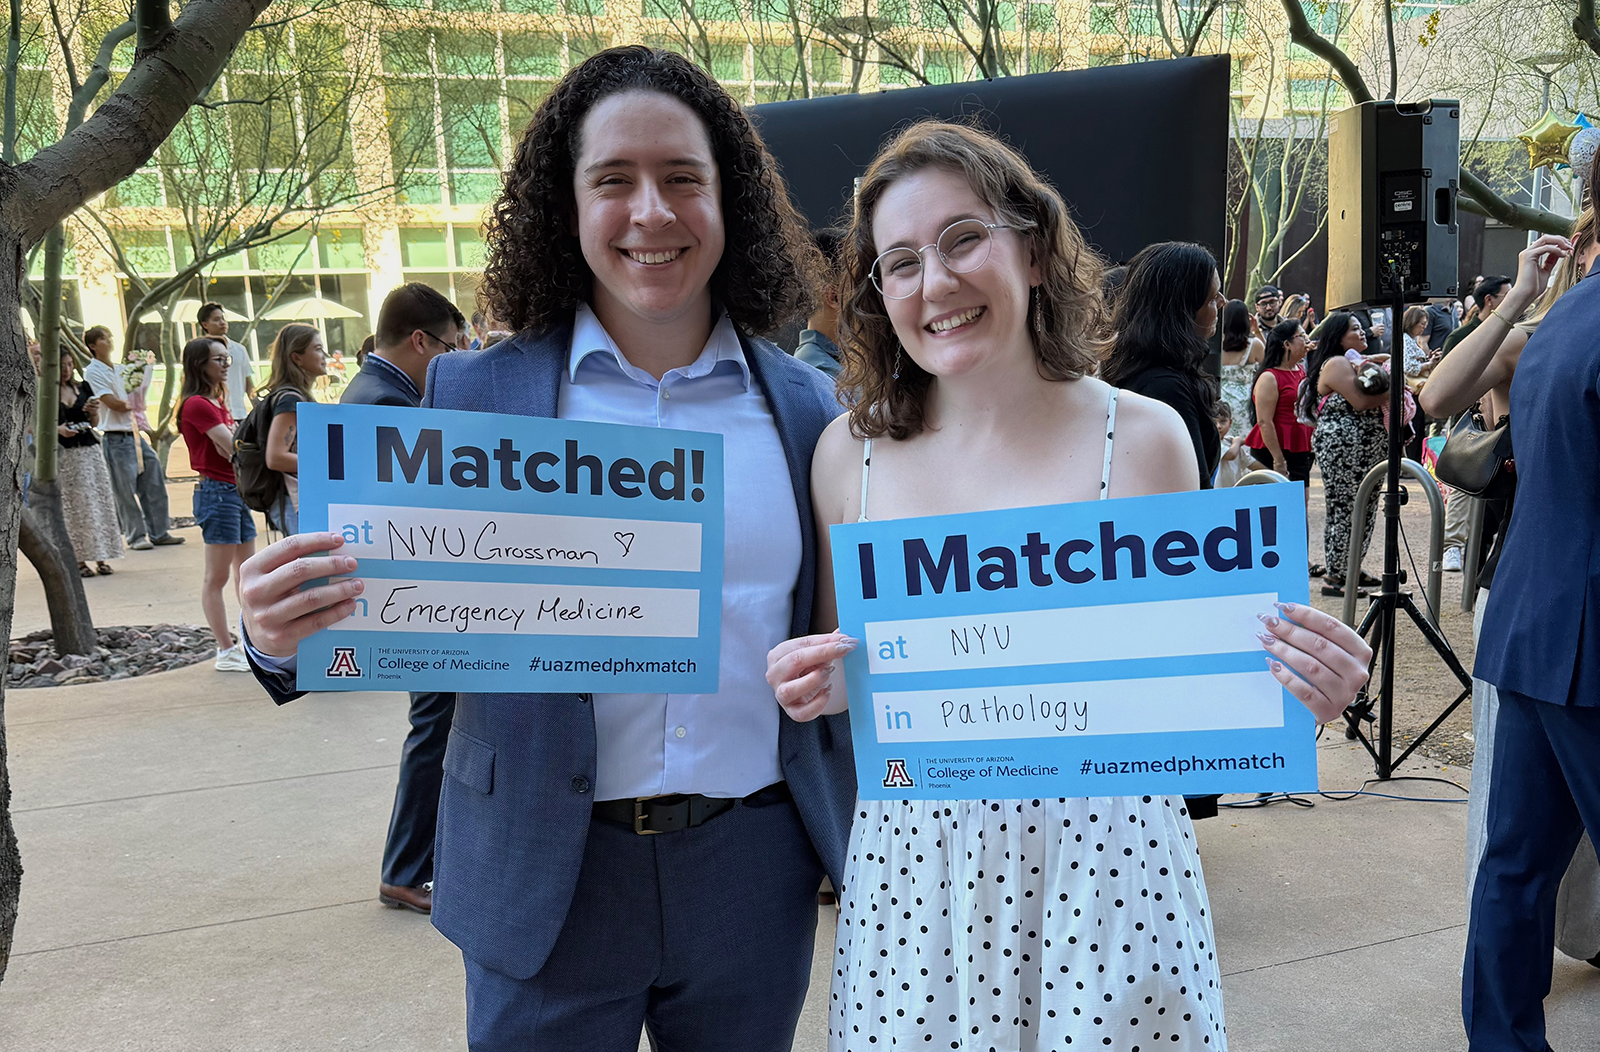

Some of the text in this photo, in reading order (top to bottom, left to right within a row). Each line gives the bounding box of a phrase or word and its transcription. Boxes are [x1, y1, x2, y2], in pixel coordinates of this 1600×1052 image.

[328, 423, 706, 503] I Matched!
[342, 520, 374, 545] at
[387, 519, 600, 565] NYU Grossman
[857, 505, 1281, 600] I Matched!
[380, 585, 645, 633] Emergency Medicine
[392, 648, 431, 656] UNIVERSITY
[878, 635, 909, 660] at
[951, 623, 1012, 656] NYU
[326, 647, 362, 678] A
[378, 657, 510, 673] College of Medicine
[528, 656, 697, 676] #uazmedphxmatch
[885, 704, 913, 731] in
[882, 758, 914, 788] A
[927, 765, 1059, 781] College of Medicine
[1079, 752, 1286, 775] #uazmedphxmatch
